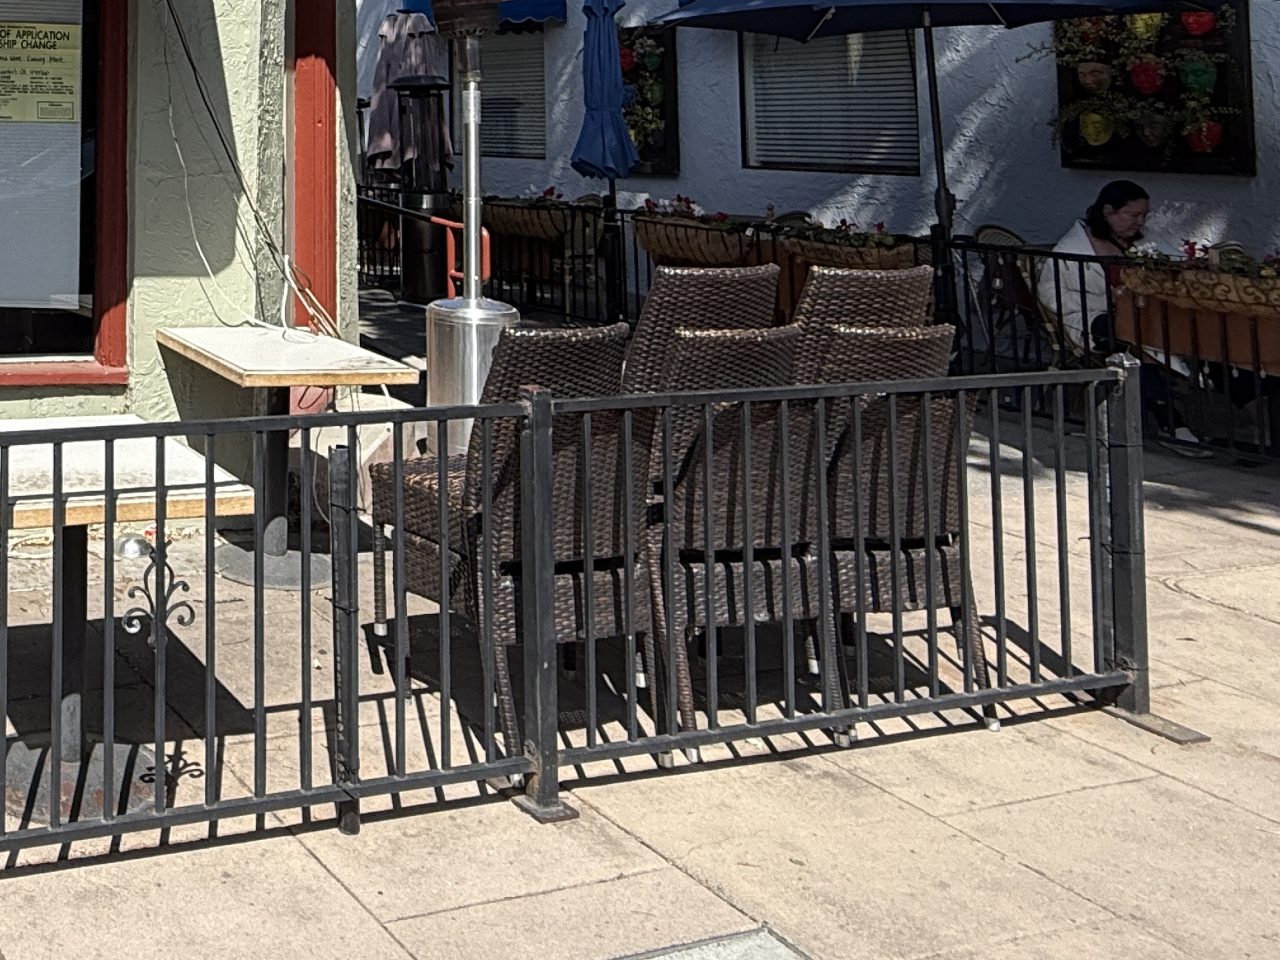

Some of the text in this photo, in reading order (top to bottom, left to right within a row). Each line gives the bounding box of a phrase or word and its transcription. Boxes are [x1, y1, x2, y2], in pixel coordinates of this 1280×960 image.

[0, 29, 11, 39] OF
[15, 30, 70, 41] APPLICATION
[20, 40, 57, 50] CHANGE
